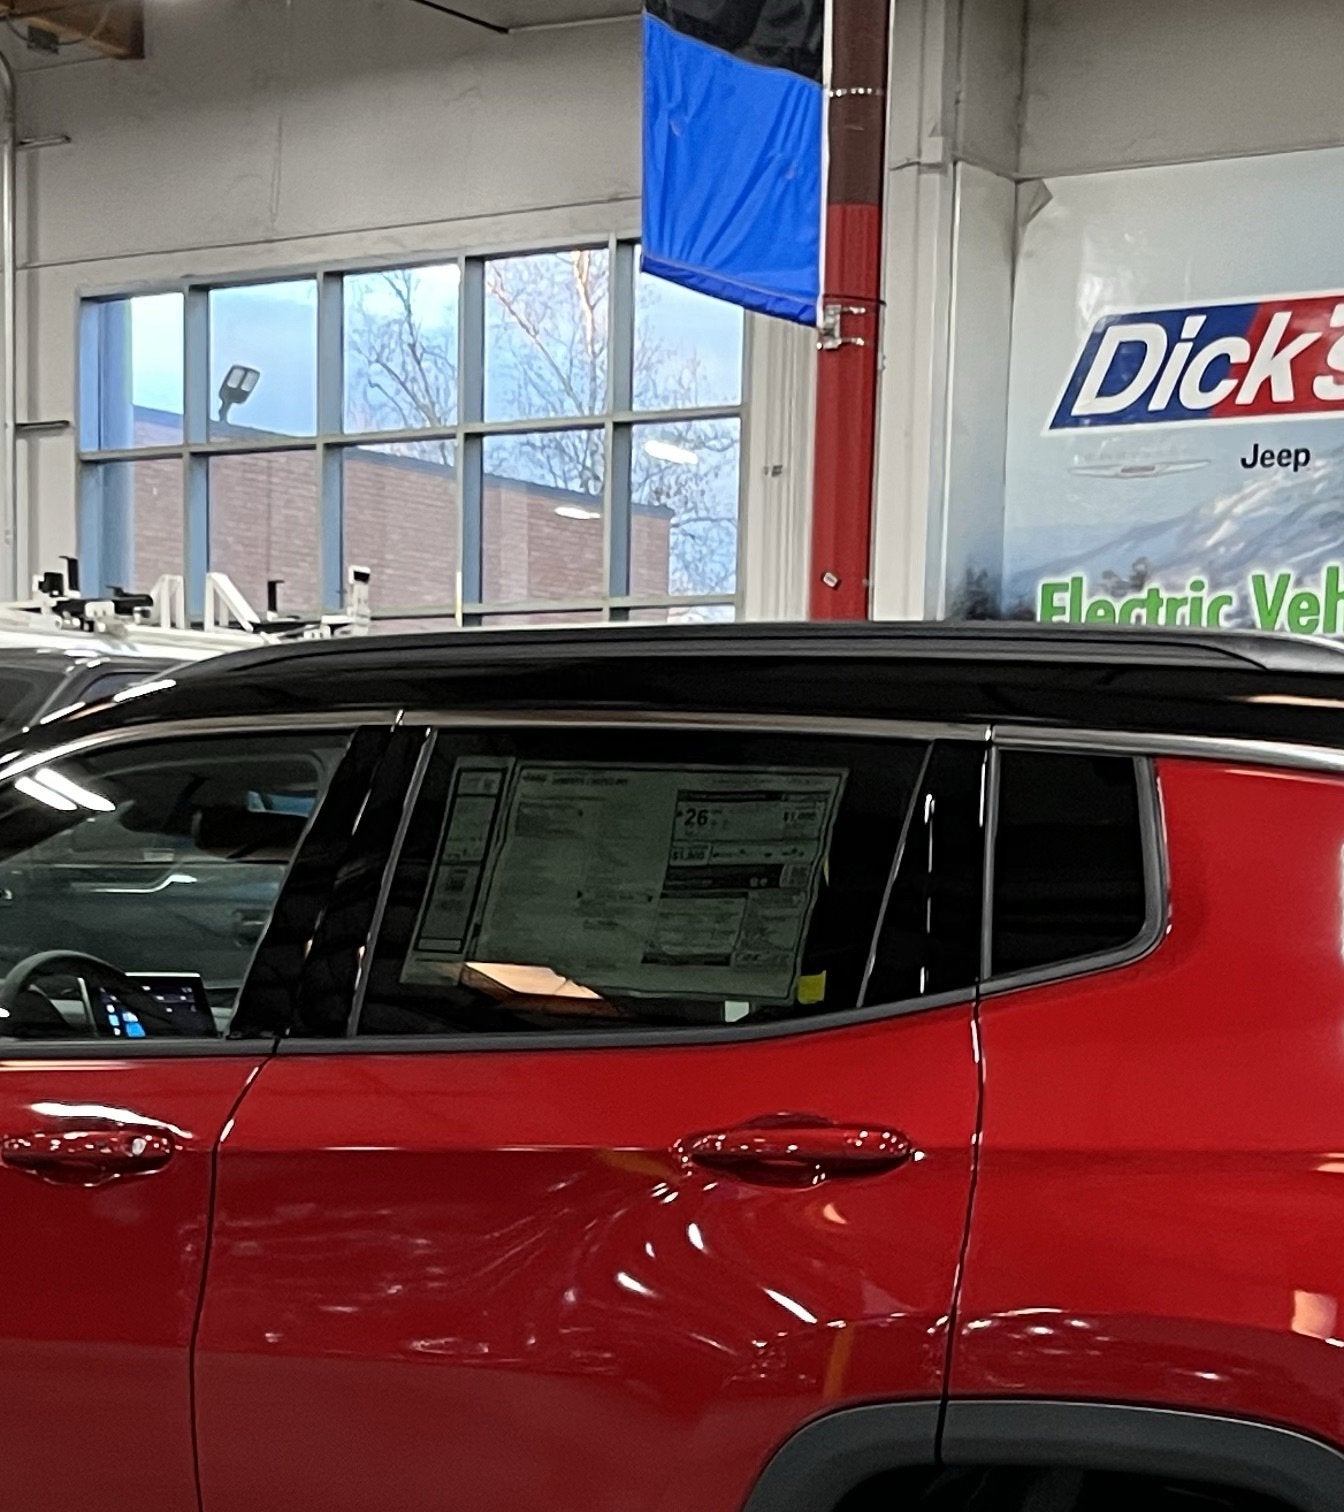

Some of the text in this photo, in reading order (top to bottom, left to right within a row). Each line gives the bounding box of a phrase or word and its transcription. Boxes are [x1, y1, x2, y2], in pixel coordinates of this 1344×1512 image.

[1240, 443, 1311, 473] Jeep
[1039, 576, 1234, 628] Electric
[683, 808, 708, 827] 26
